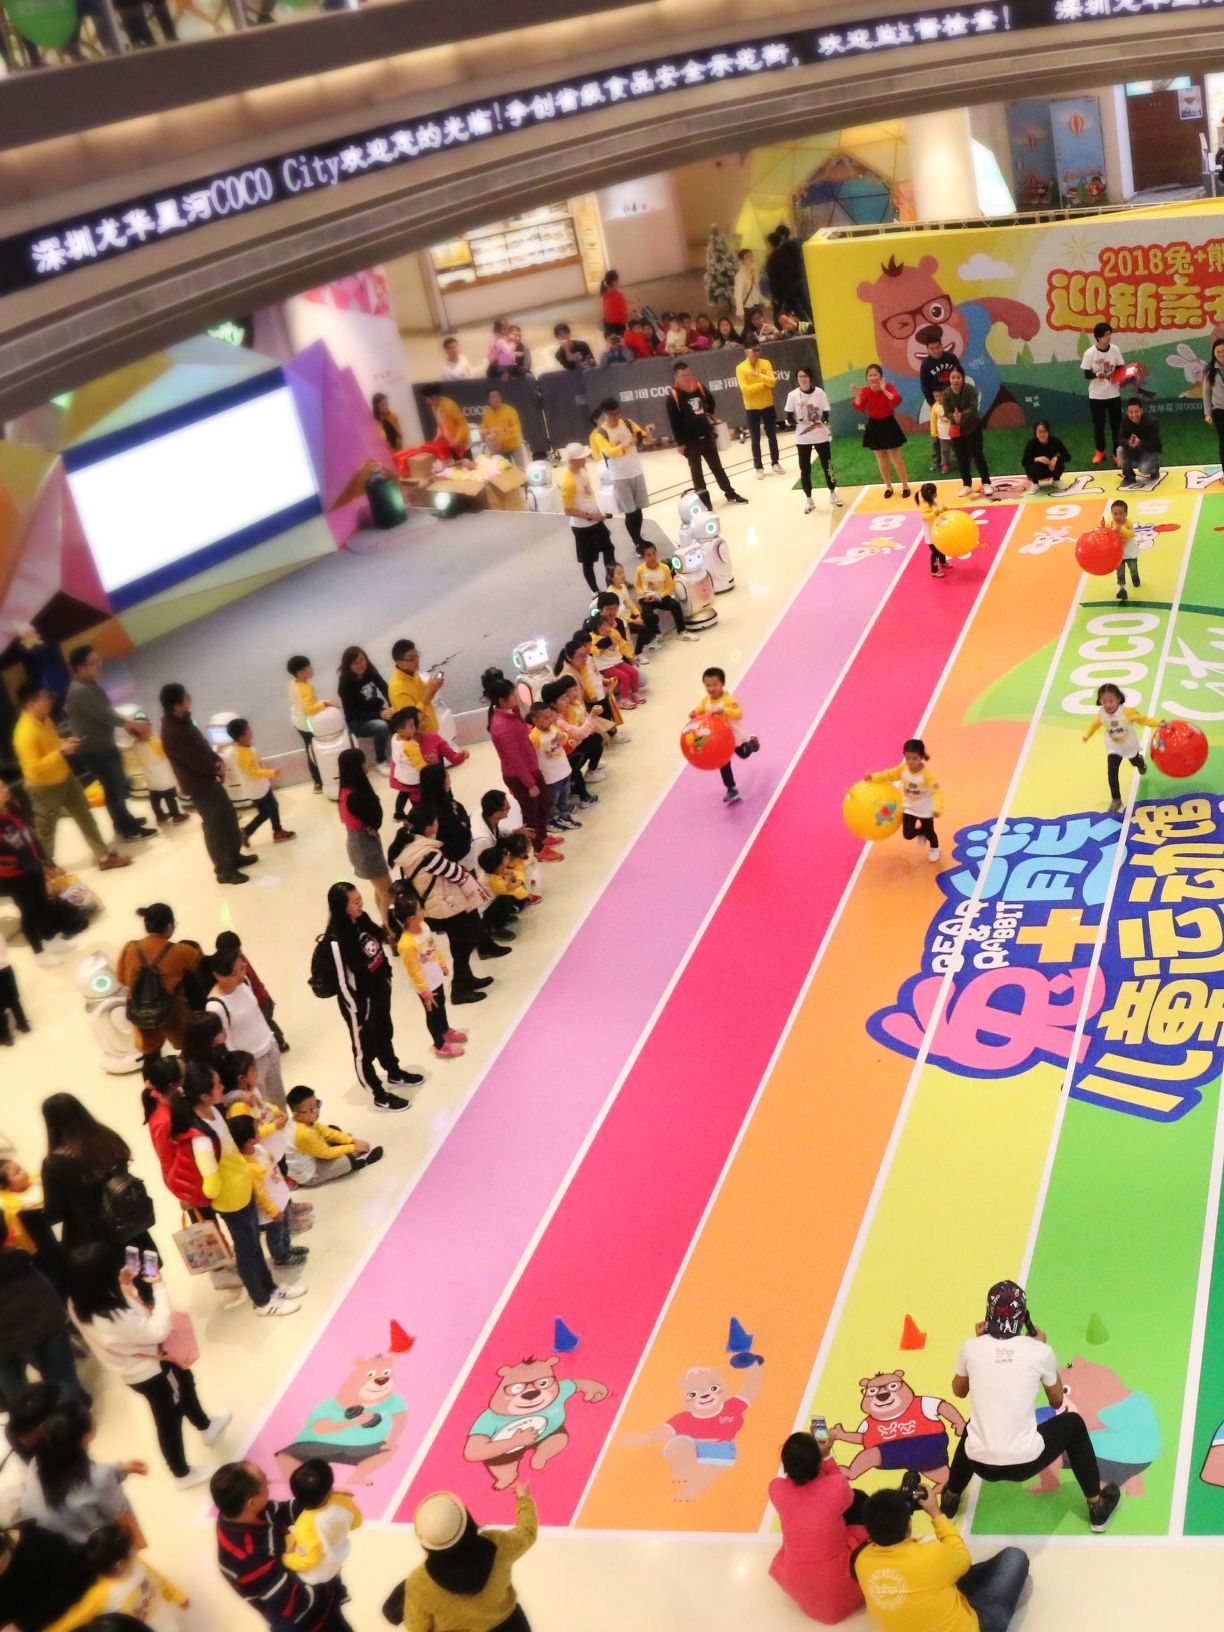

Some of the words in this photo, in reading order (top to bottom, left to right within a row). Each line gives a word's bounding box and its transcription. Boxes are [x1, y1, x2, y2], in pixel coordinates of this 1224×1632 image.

[868, 514, 907, 531] 8
[1061, 613, 1160, 714] COCO
[973, 901, 1024, 969] RABBIT
